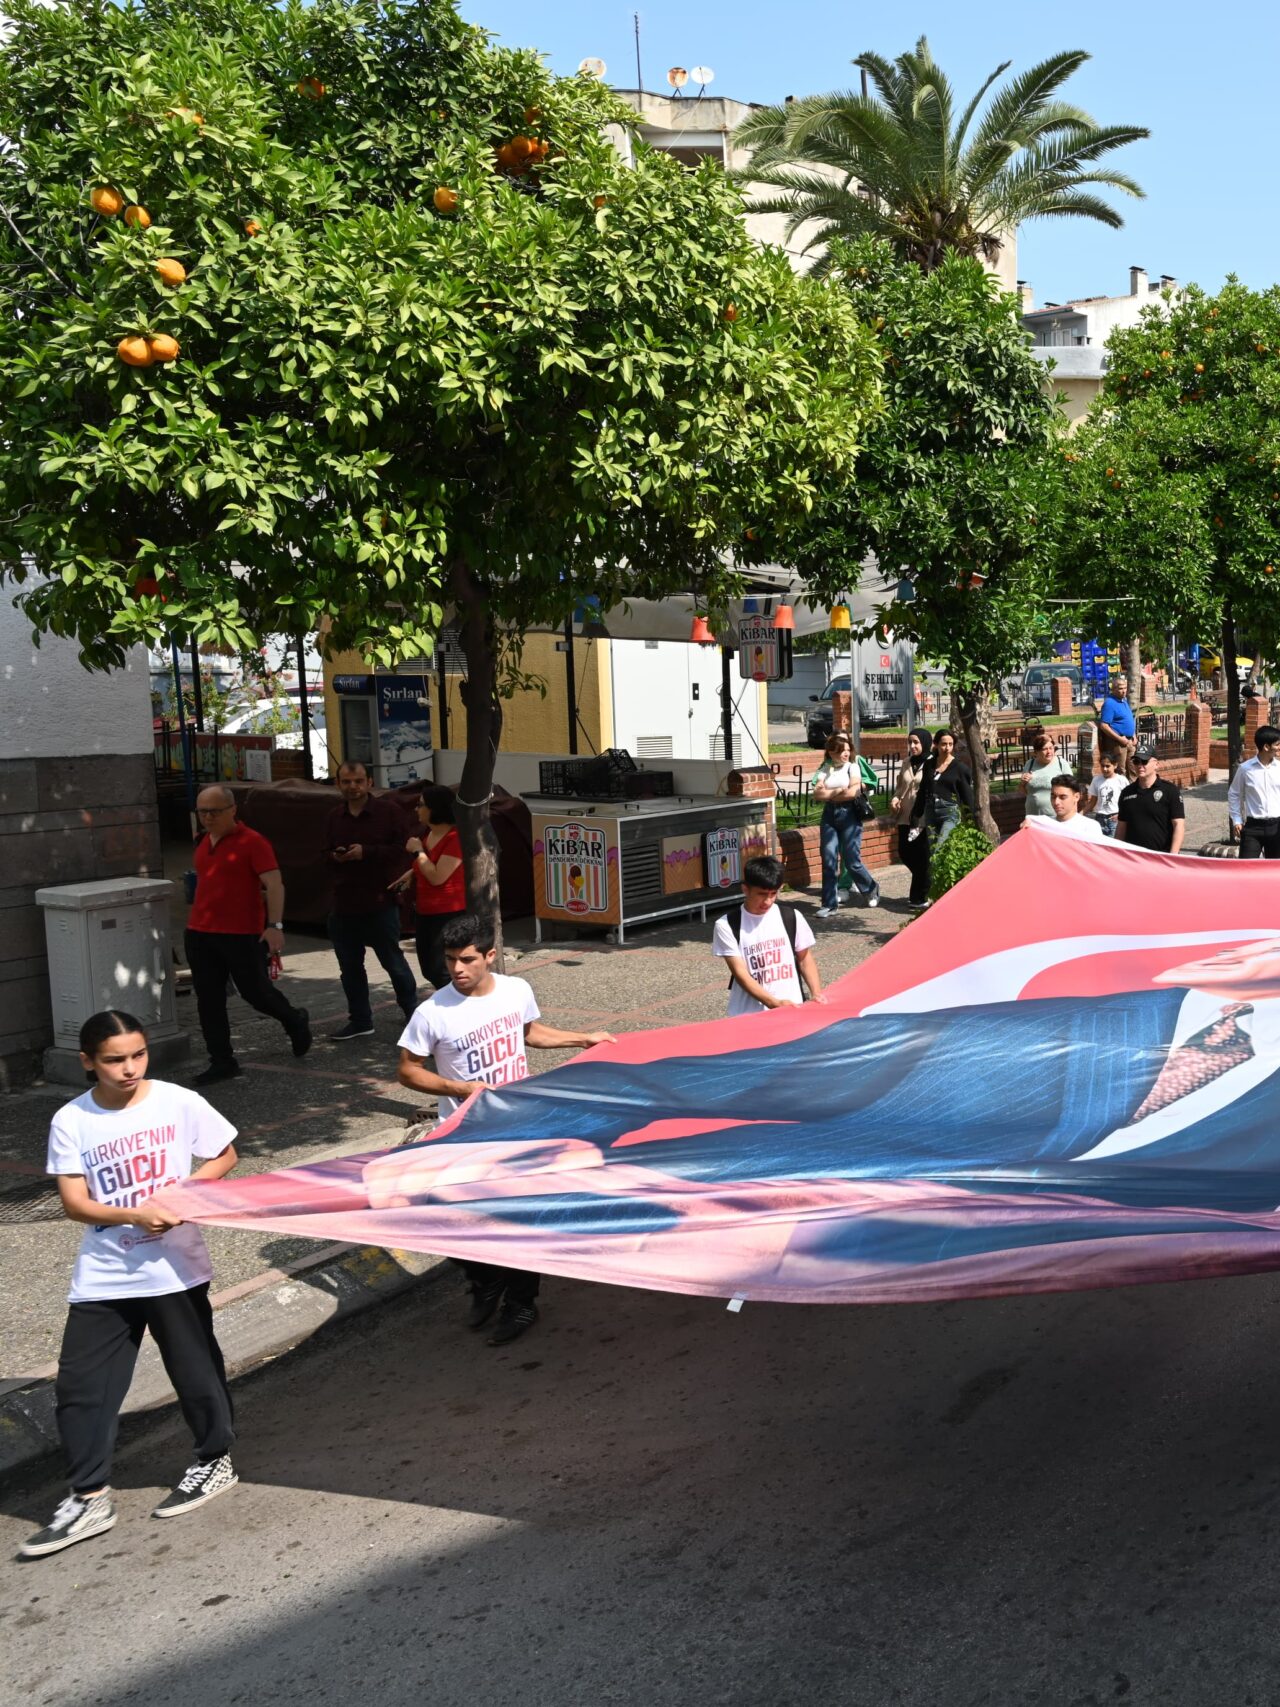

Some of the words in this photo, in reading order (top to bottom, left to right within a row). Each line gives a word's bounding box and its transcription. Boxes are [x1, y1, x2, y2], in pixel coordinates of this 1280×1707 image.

[873, 690, 897, 701] PARKI
[749, 949, 781, 970] GÜCÜ
[454, 1011, 521, 1052] TÜRKİYE'NİN
[467, 1032, 517, 1074] GÜCÜ
[81, 1124, 175, 1169] TÜRKİYE'NİN
[97, 1149, 166, 1195] GÜCÜ
